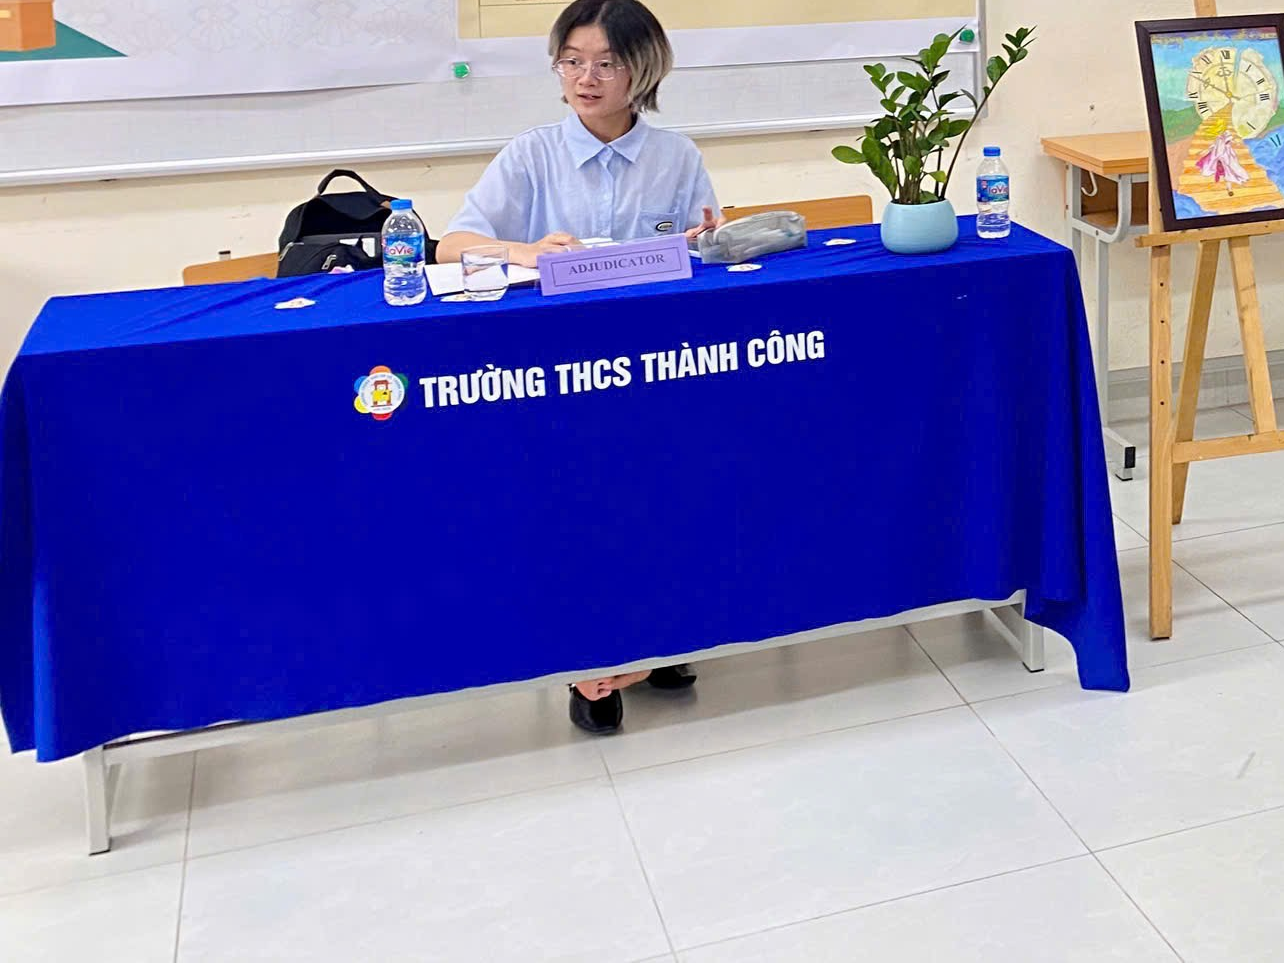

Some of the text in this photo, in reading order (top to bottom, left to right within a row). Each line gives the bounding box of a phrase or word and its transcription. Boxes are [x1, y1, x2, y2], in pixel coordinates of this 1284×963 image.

[568, 253, 665, 276] ADJUDICATOR
[419, 365, 547, 408] TRƯỜNG
[554, 356, 631, 395] THCS
[640, 341, 739, 383] THÀNH
[747, 330, 826, 368] CÔNG
